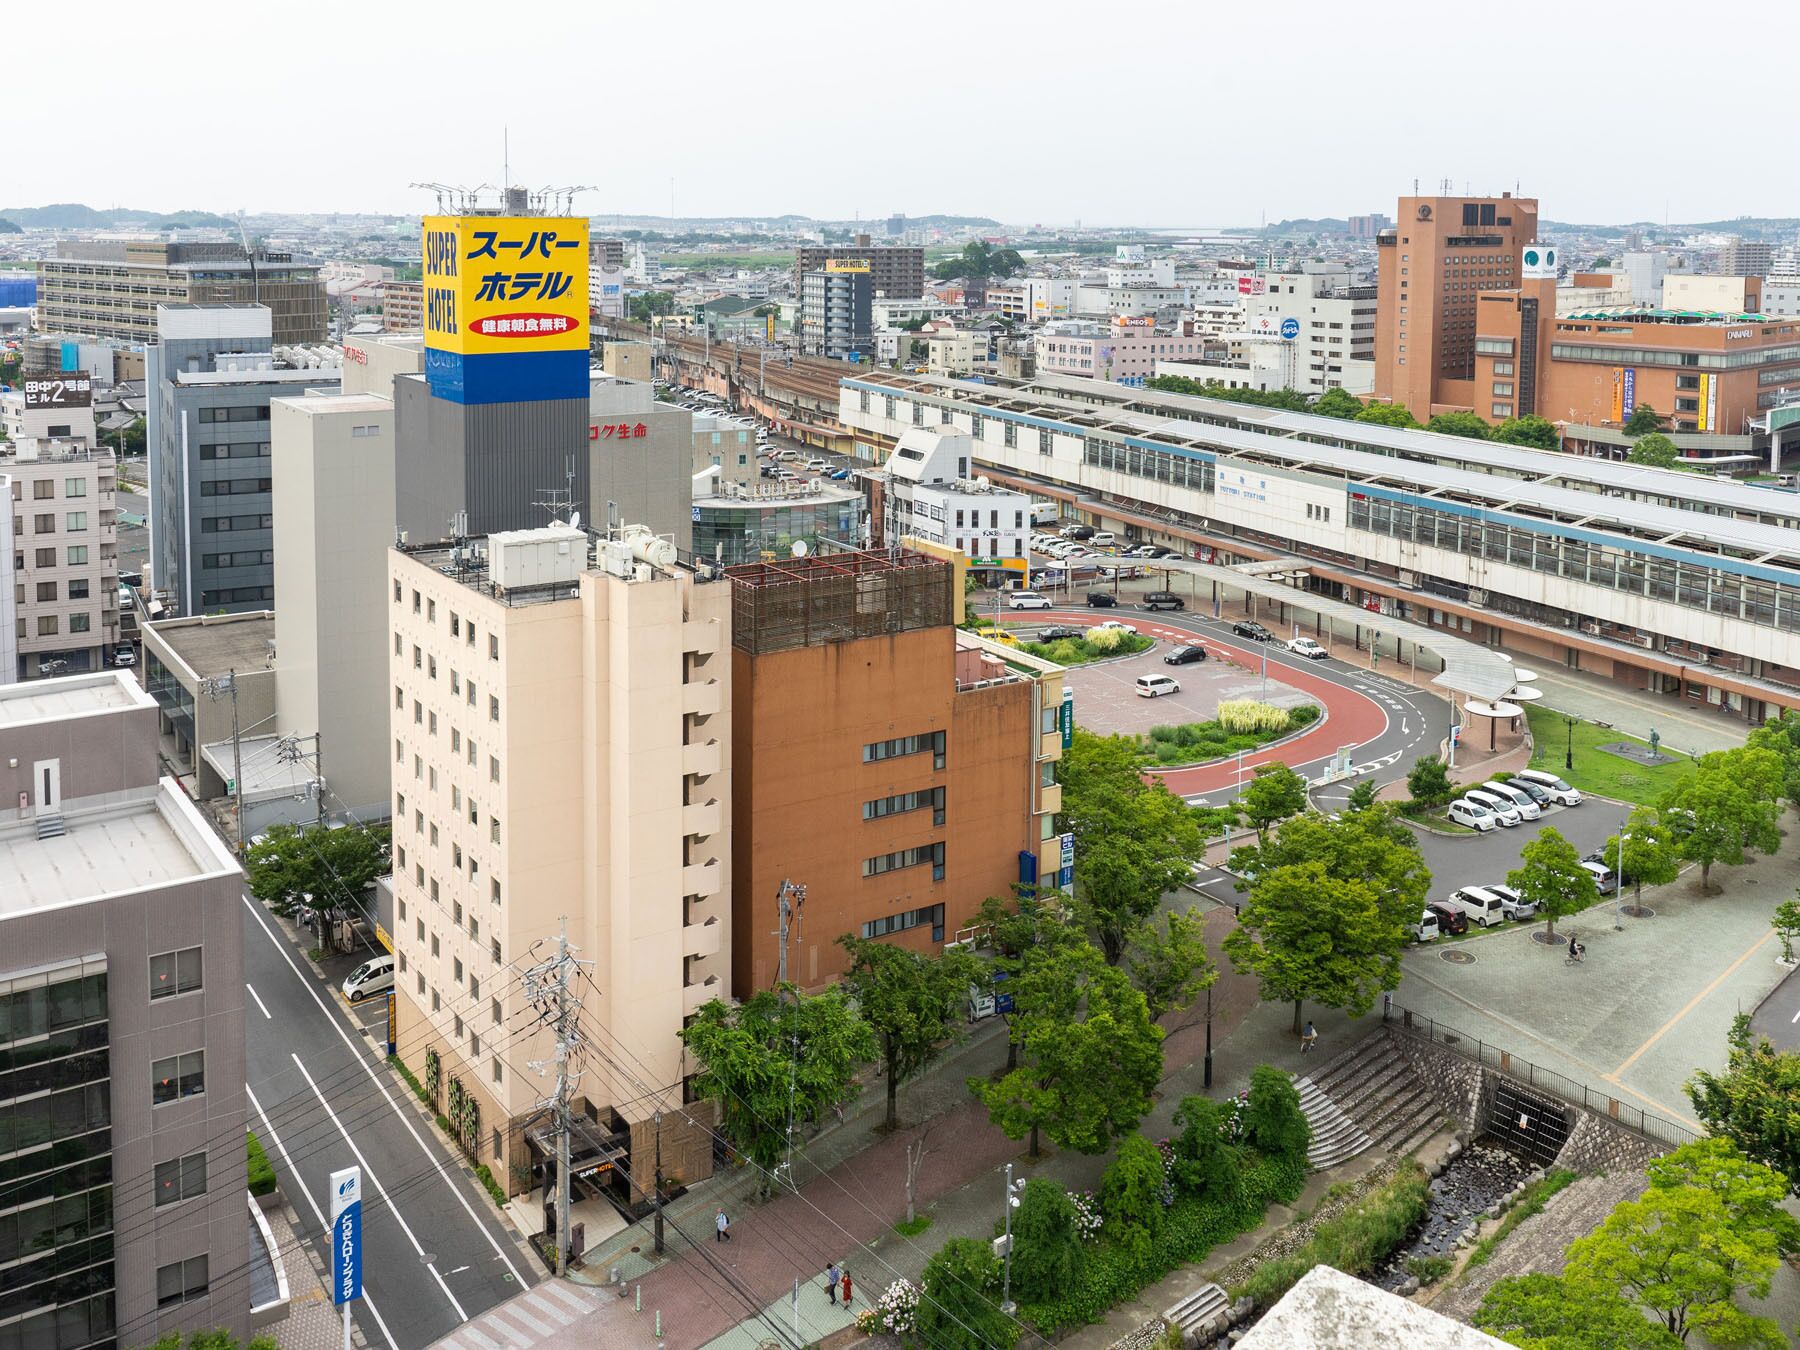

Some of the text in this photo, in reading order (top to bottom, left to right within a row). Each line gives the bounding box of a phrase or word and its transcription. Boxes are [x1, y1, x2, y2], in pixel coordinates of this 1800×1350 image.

[427, 231, 457, 277] SUPER
[466, 231, 580, 260] スーパー
[474, 271, 574, 302] ホテル
[427, 287, 458, 336] HOTEL
[481, 317, 567, 333] 健康朝食無料
[26, 393, 51, 404] ビル
[1243, 491, 1266, 502] STATION
[579, 1167, 598, 1179] SUPER
